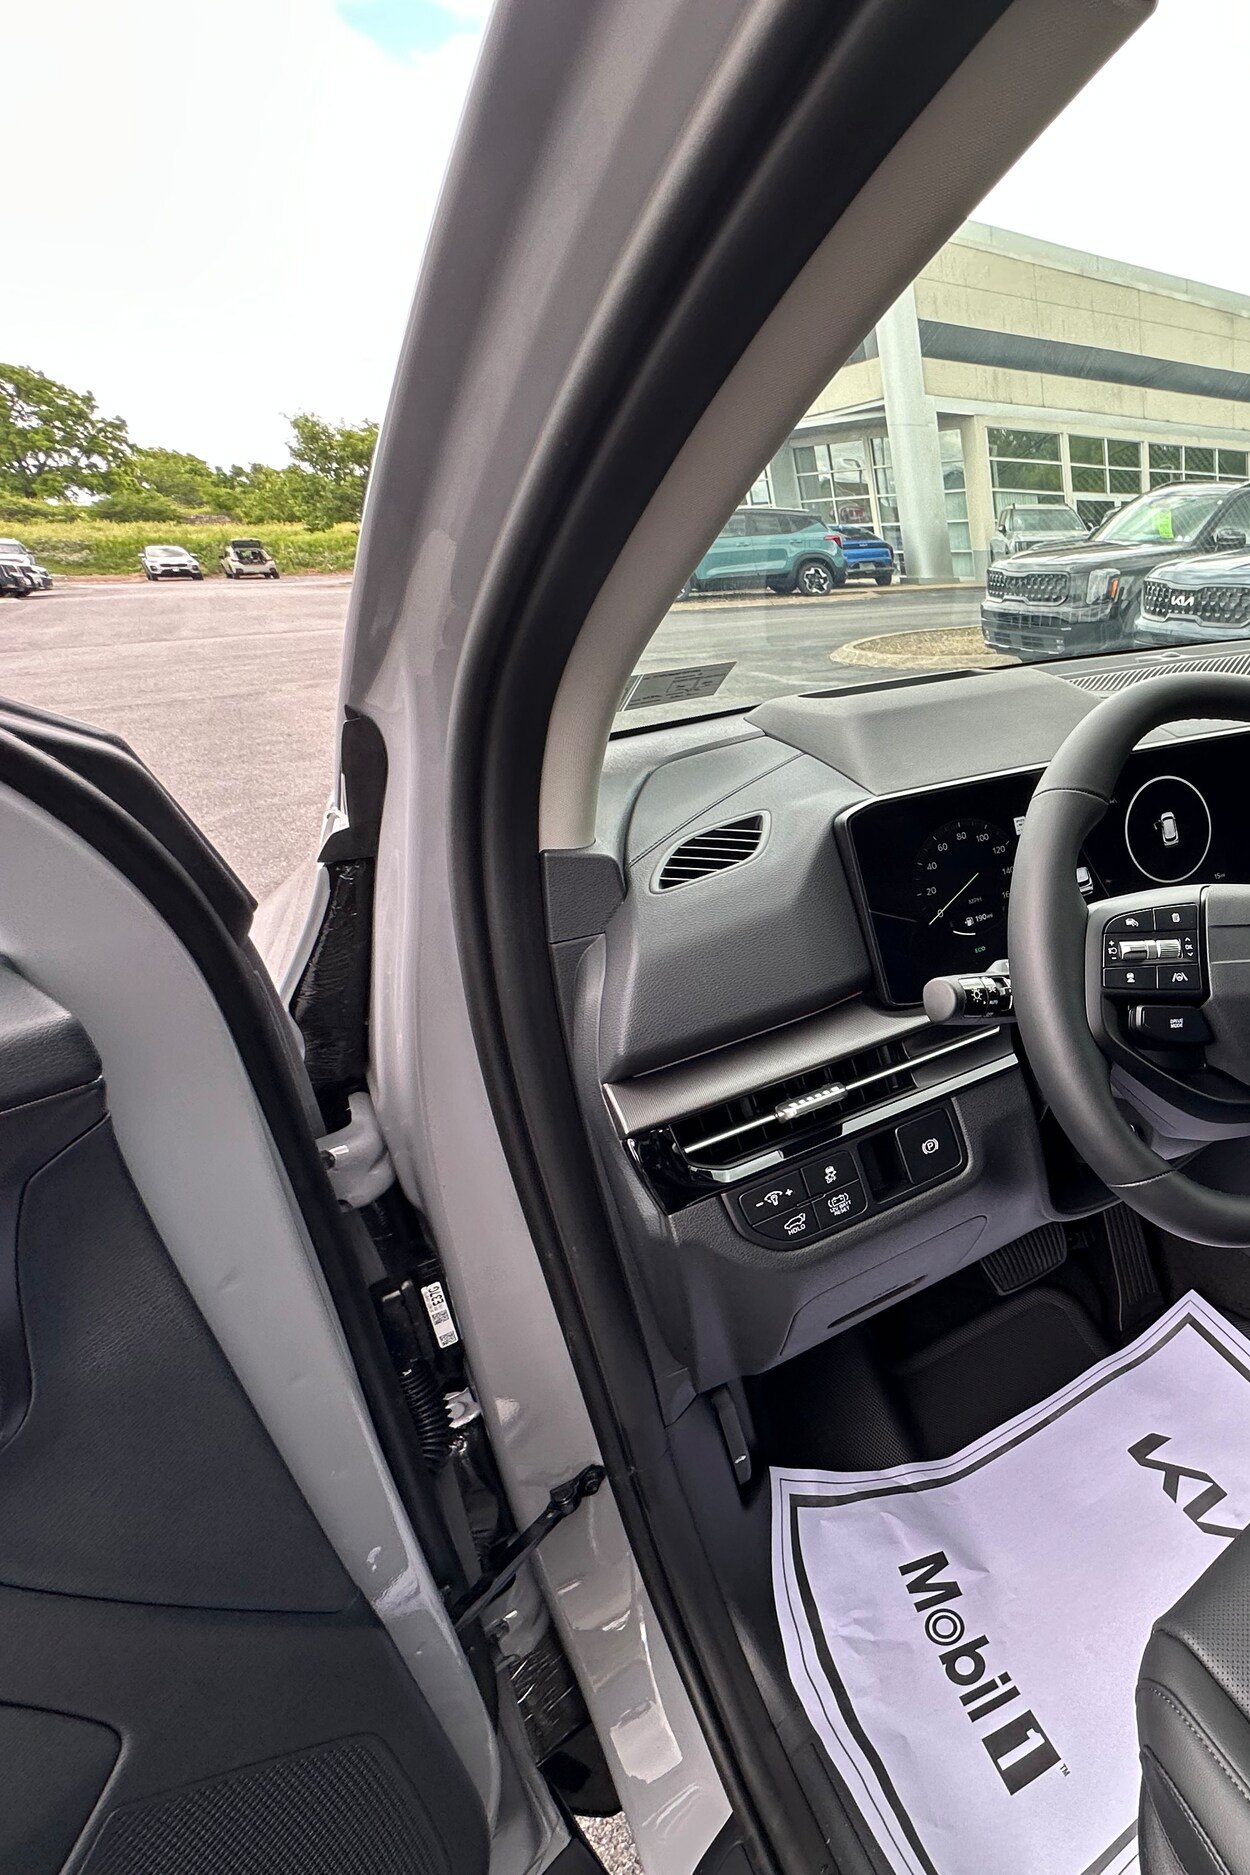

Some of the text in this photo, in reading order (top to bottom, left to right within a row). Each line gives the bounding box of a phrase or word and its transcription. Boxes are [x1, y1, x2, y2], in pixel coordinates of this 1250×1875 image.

[1171, 595, 1194, 606] KIA
[956, 832, 967, 841] 80
[976, 833, 989, 843] 100
[937, 842, 948, 852] 60
[992, 845, 1006, 855] 120
[926, 862, 938, 871] 40
[926, 887, 937, 896] 20
[1002, 891, 1010, 899] 16
[968, 896, 983, 904] MPH
[975, 945, 986, 953] ECO
[788, 1223, 806, 1235] HOLD
[898, 1551, 1021, 1723] Mobil
